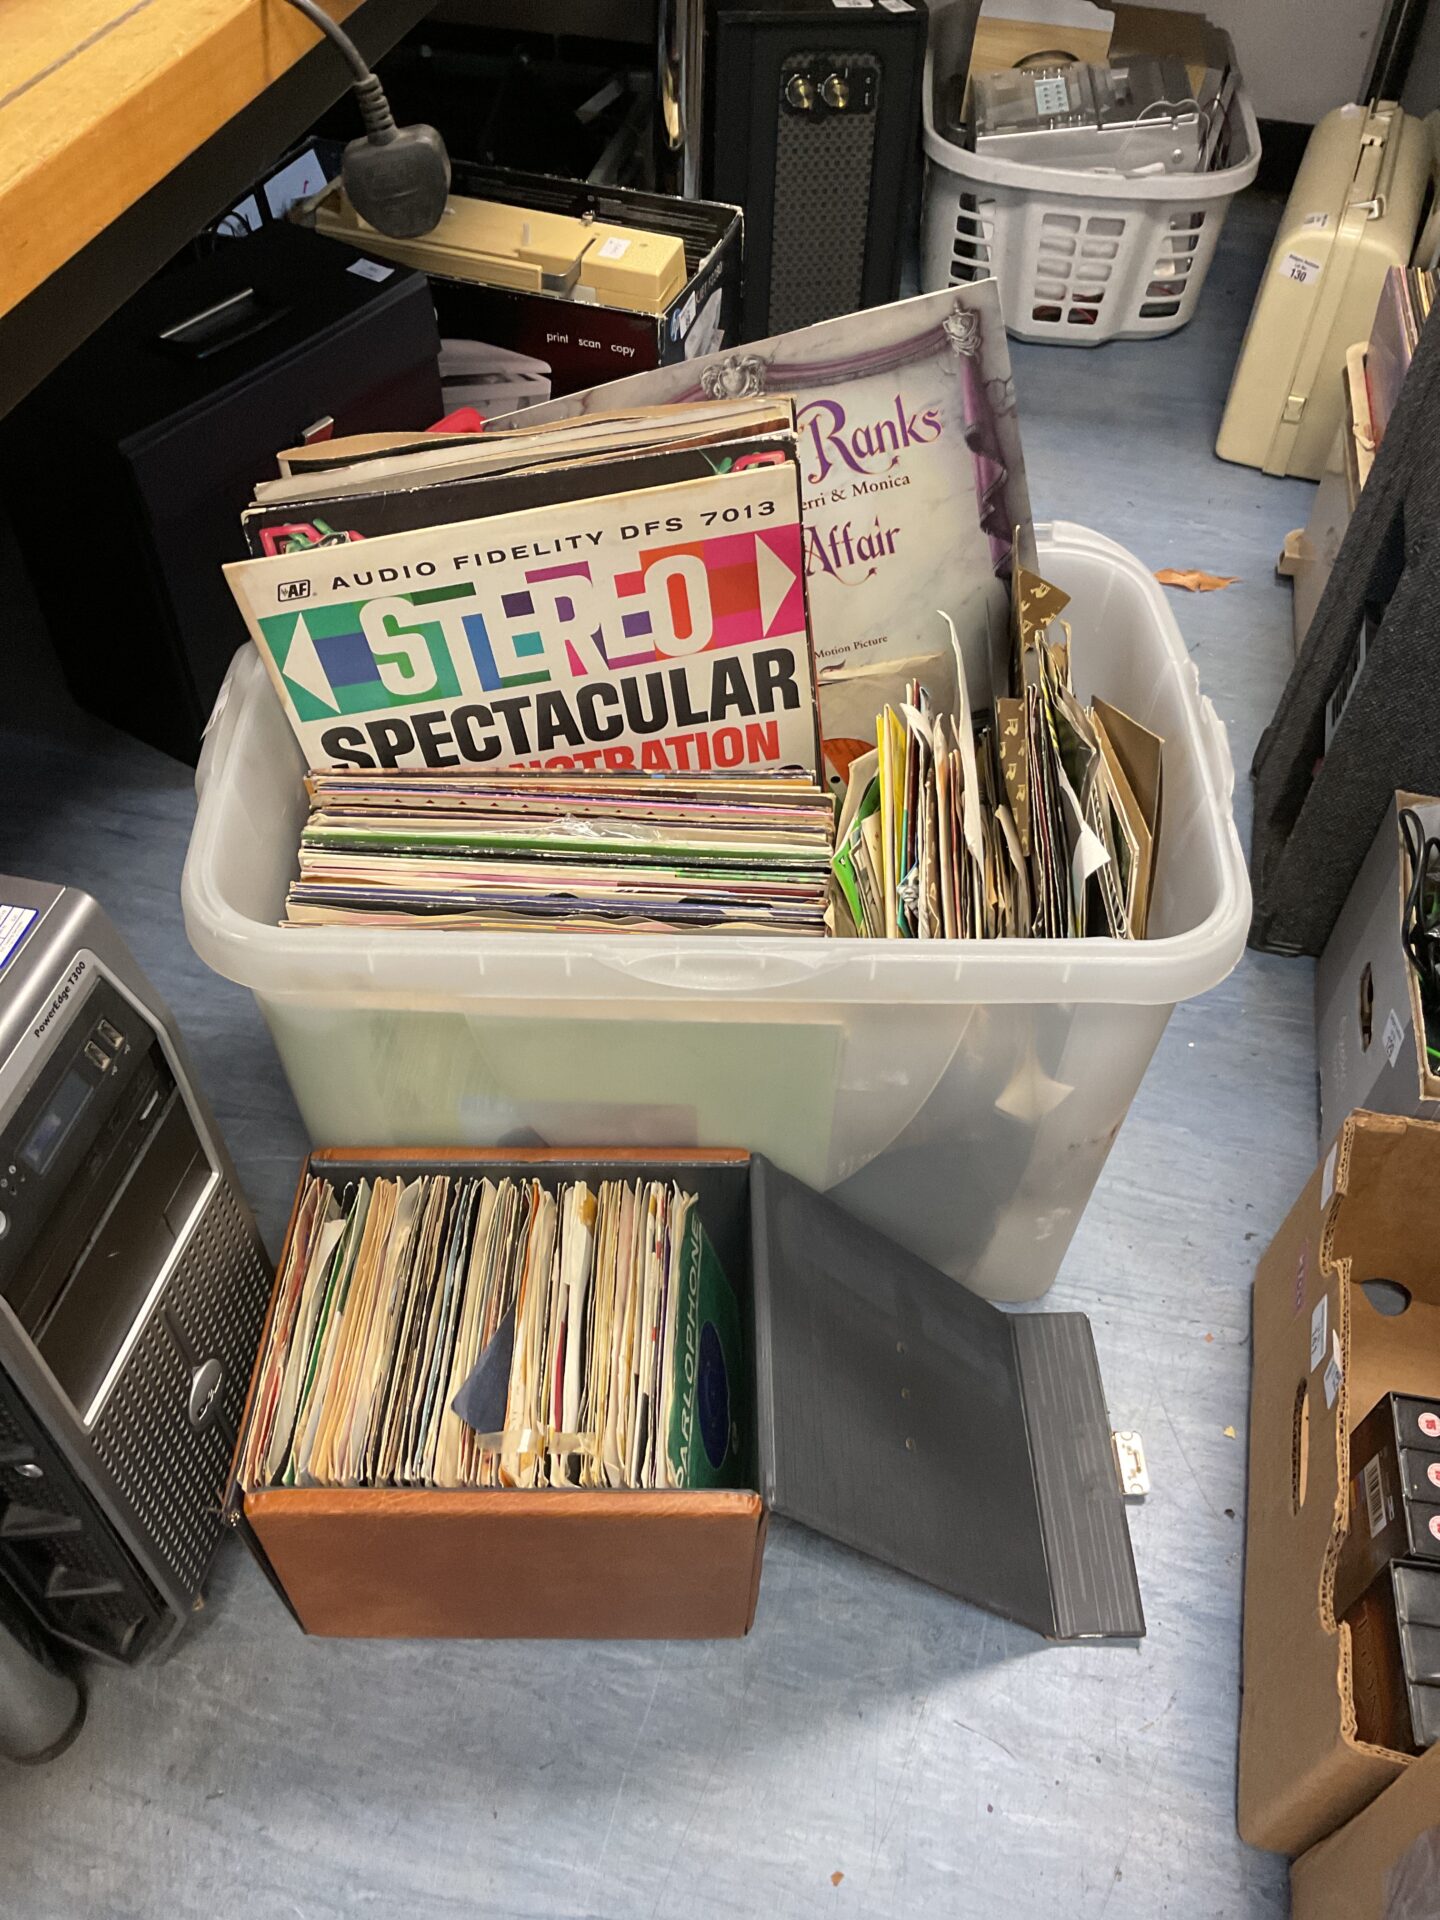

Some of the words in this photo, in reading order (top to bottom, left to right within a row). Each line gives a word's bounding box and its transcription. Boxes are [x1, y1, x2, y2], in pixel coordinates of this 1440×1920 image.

[1290, 268, 1307, 282] 130
[546, 332, 569, 344] print
[578, 338, 601, 349] scan
[610, 344, 635, 358] copy
[797, 394, 943, 485] Ranks
[801, 492, 827, 511] erri
[830, 489, 848, 502] &
[852, 475, 911, 497] Monica
[331, 561, 436, 590] AUDIO
[453, 531, 605, 571] FIDELITY
[621, 517, 683, 542] DFS
[700, 500, 777, 527] 7013
[804, 514, 900, 586] Affair
[360, 552, 714, 697] STEREO
[814, 645, 851, 660] Motion
[853, 635, 888, 651] Picture
[321, 647, 801, 769] SPECTACULAR
[34, 985, 72, 1038] PowerEdge
[68, 960, 86, 986] T300
[675, 1211, 702, 1488] PARLOPHONE
